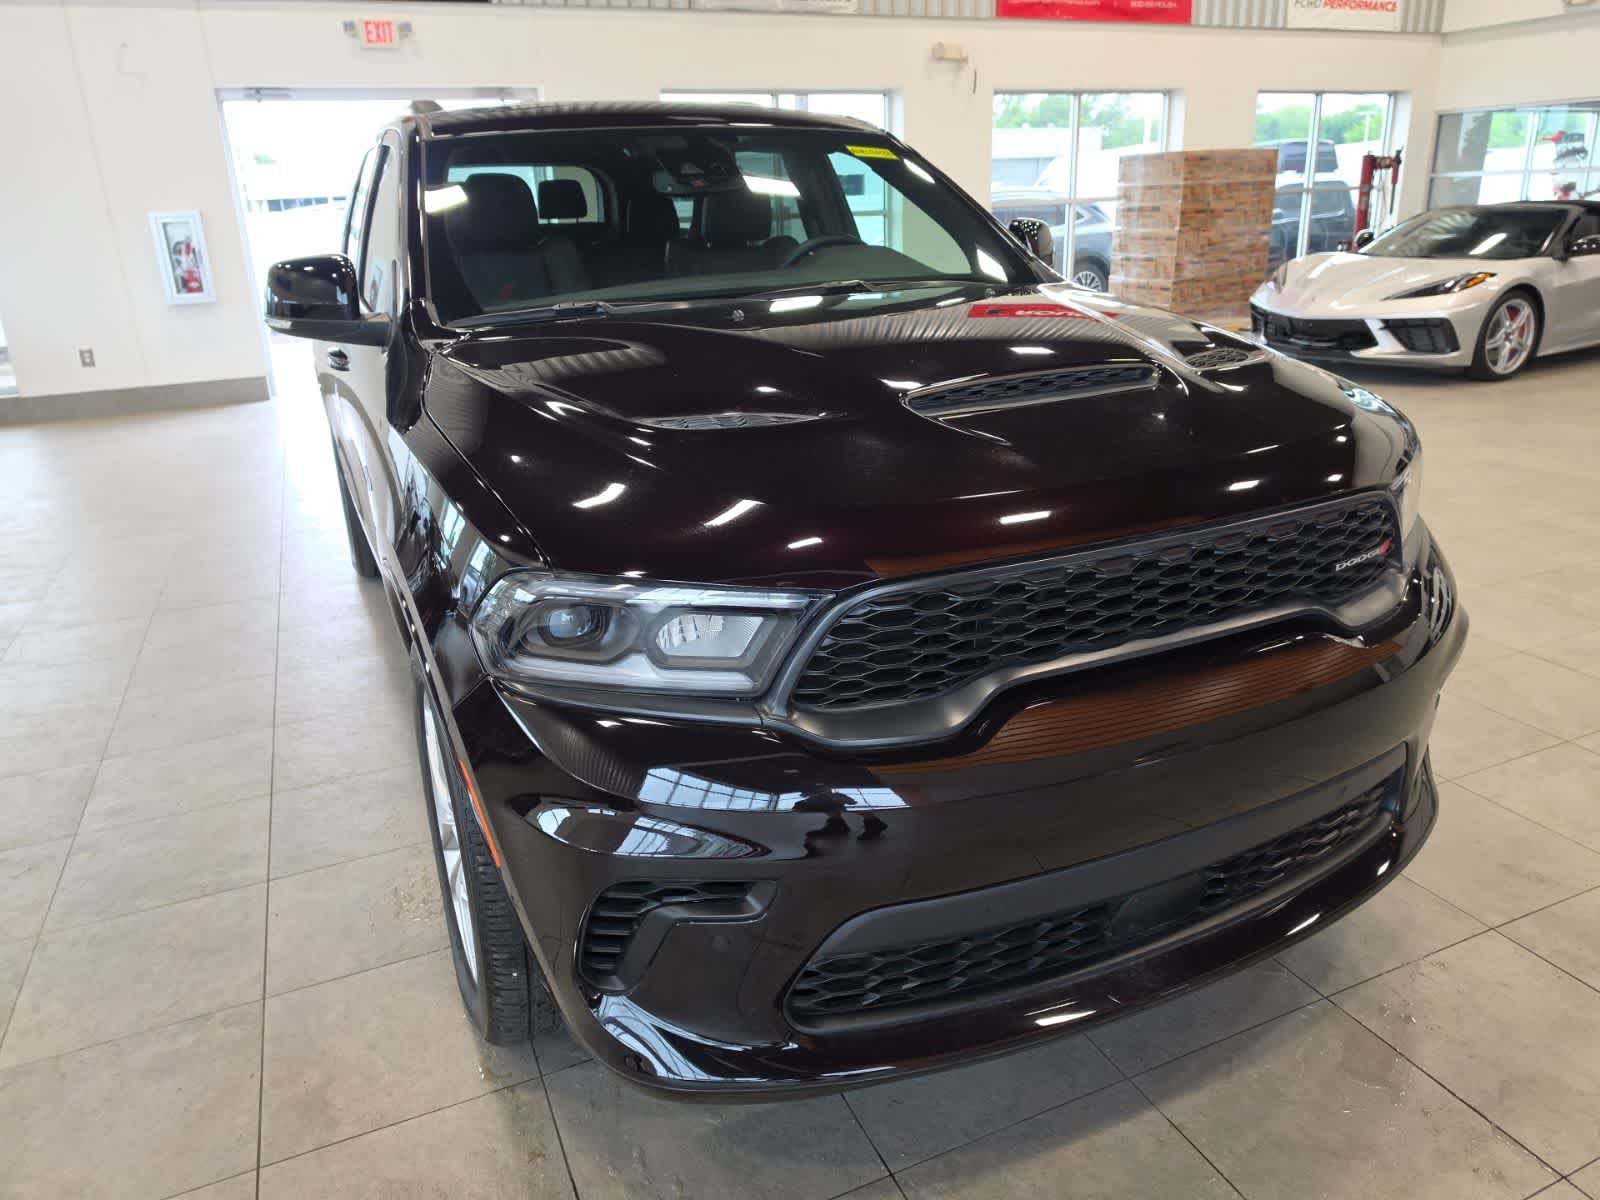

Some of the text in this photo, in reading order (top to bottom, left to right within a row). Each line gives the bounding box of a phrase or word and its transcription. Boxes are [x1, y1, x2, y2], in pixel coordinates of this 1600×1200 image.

[1323, 0, 1398, 12] PERFORMANCE
[364, 20, 392, 44] EXIT
[1335, 547, 1380, 571] DODGE
